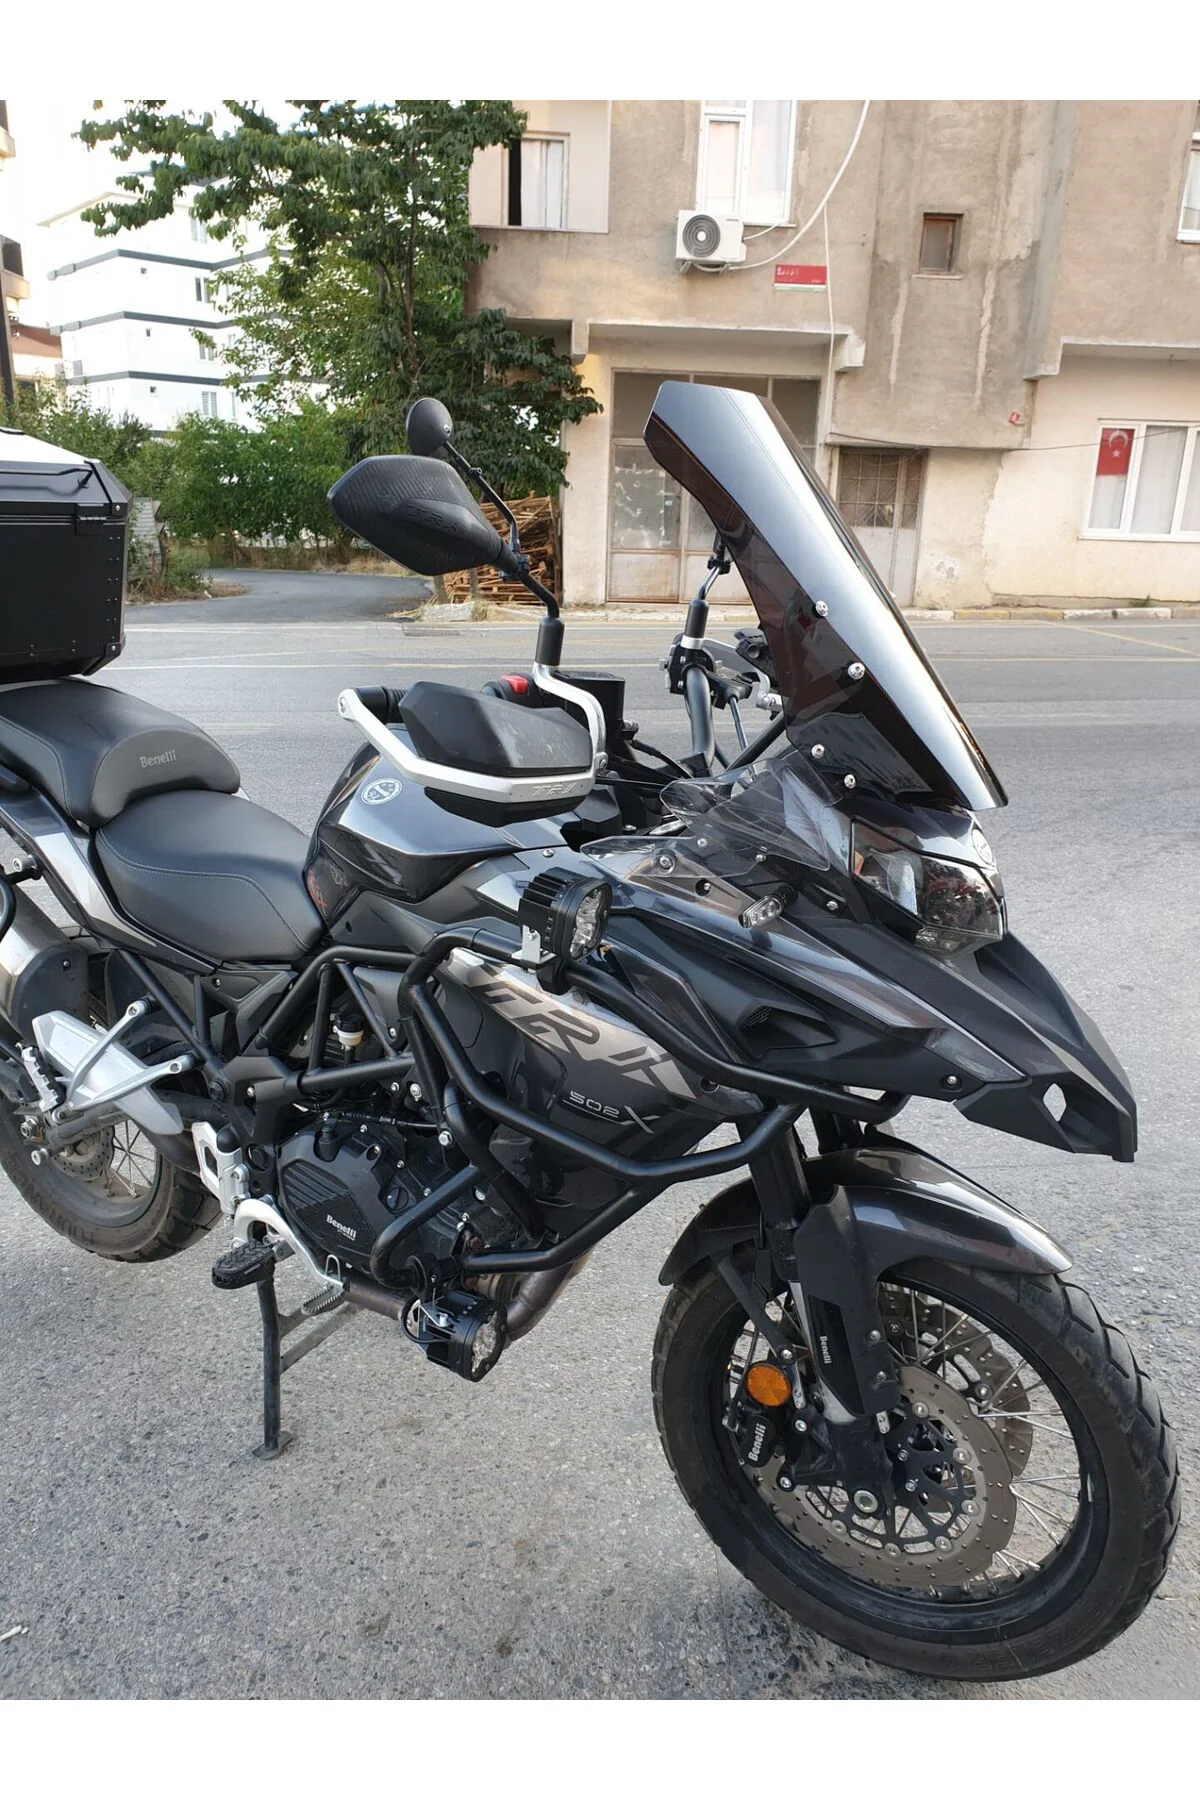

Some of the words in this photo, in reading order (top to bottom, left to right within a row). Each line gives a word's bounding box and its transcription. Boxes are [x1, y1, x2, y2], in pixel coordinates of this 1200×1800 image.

[140, 749, 177, 768] Benelli
[326, 1213, 357, 1239] Benelli
[819, 1335, 833, 1364] Benelli
[747, 1422, 767, 1462] Benelli
